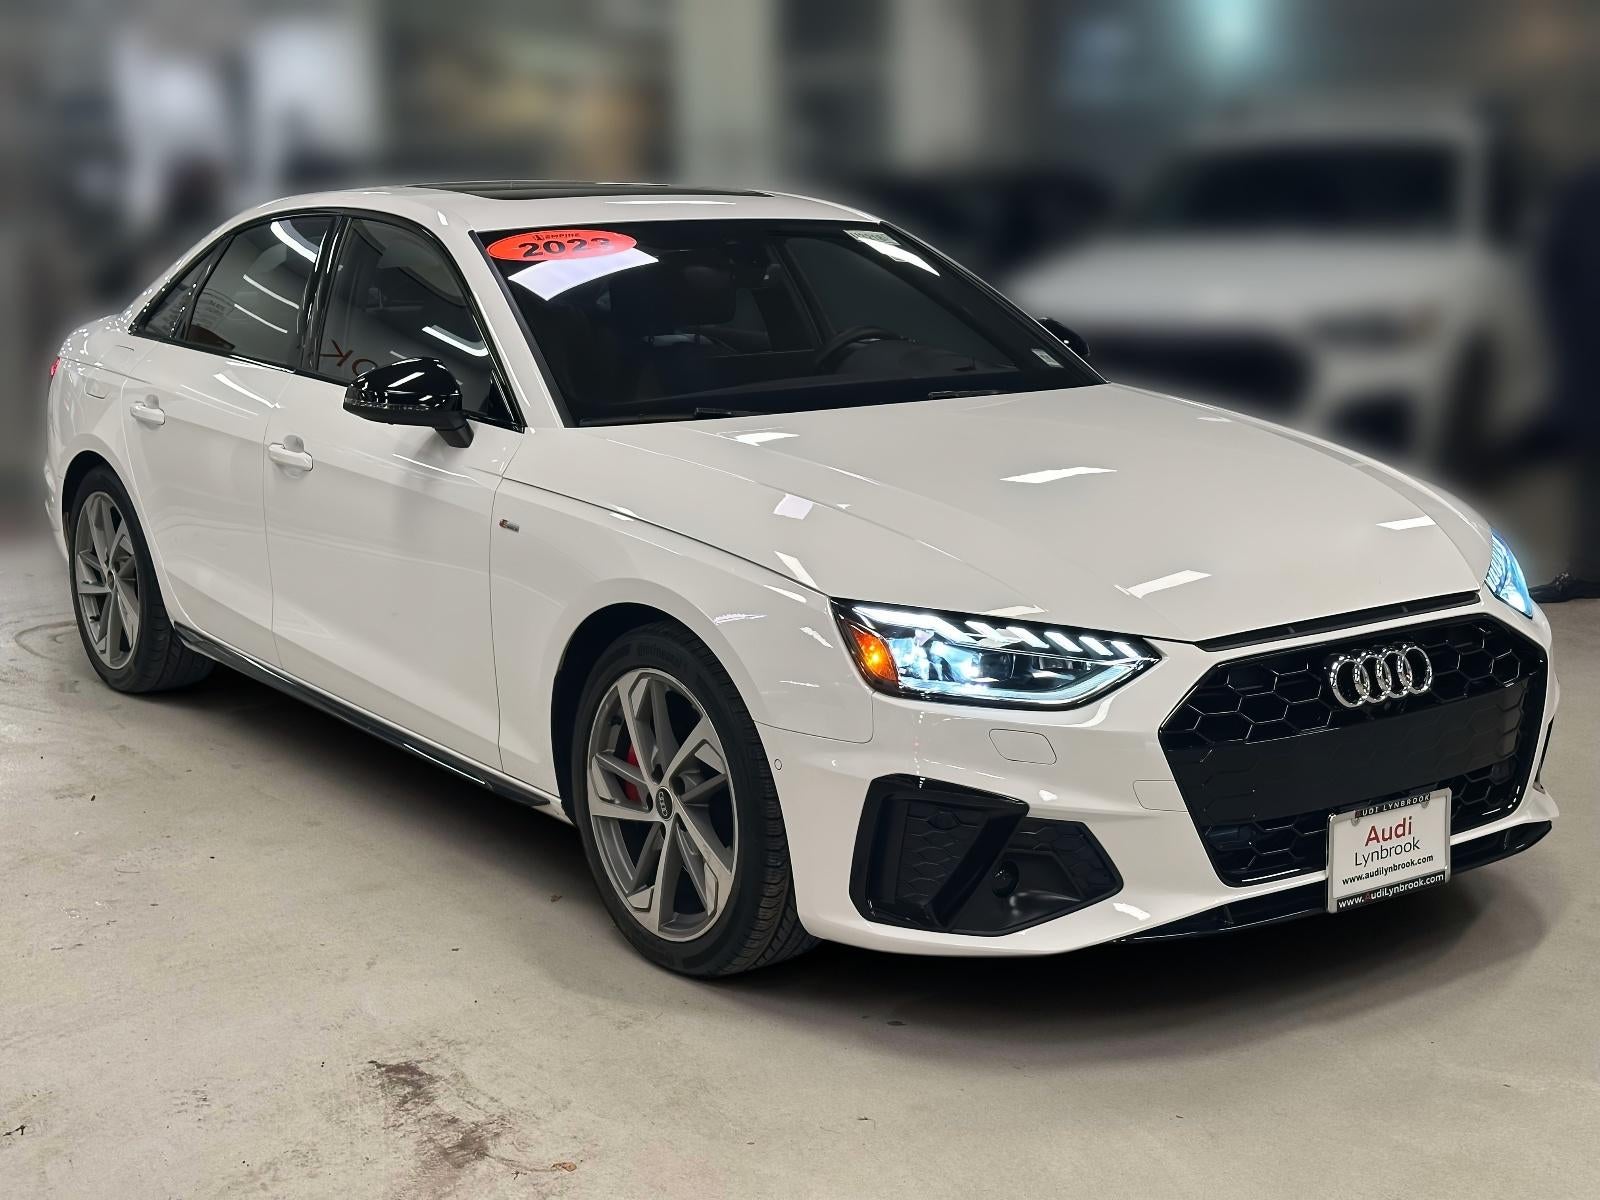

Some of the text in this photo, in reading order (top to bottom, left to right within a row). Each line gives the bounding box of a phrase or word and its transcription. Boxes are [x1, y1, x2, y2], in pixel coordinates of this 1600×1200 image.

[1383, 794, 1430, 811] LYNBROOK
[1365, 816, 1412, 847] Audi
[1354, 837, 1421, 868] Lynbrook
[1341, 855, 1434, 885] www.audilynbrook.com
